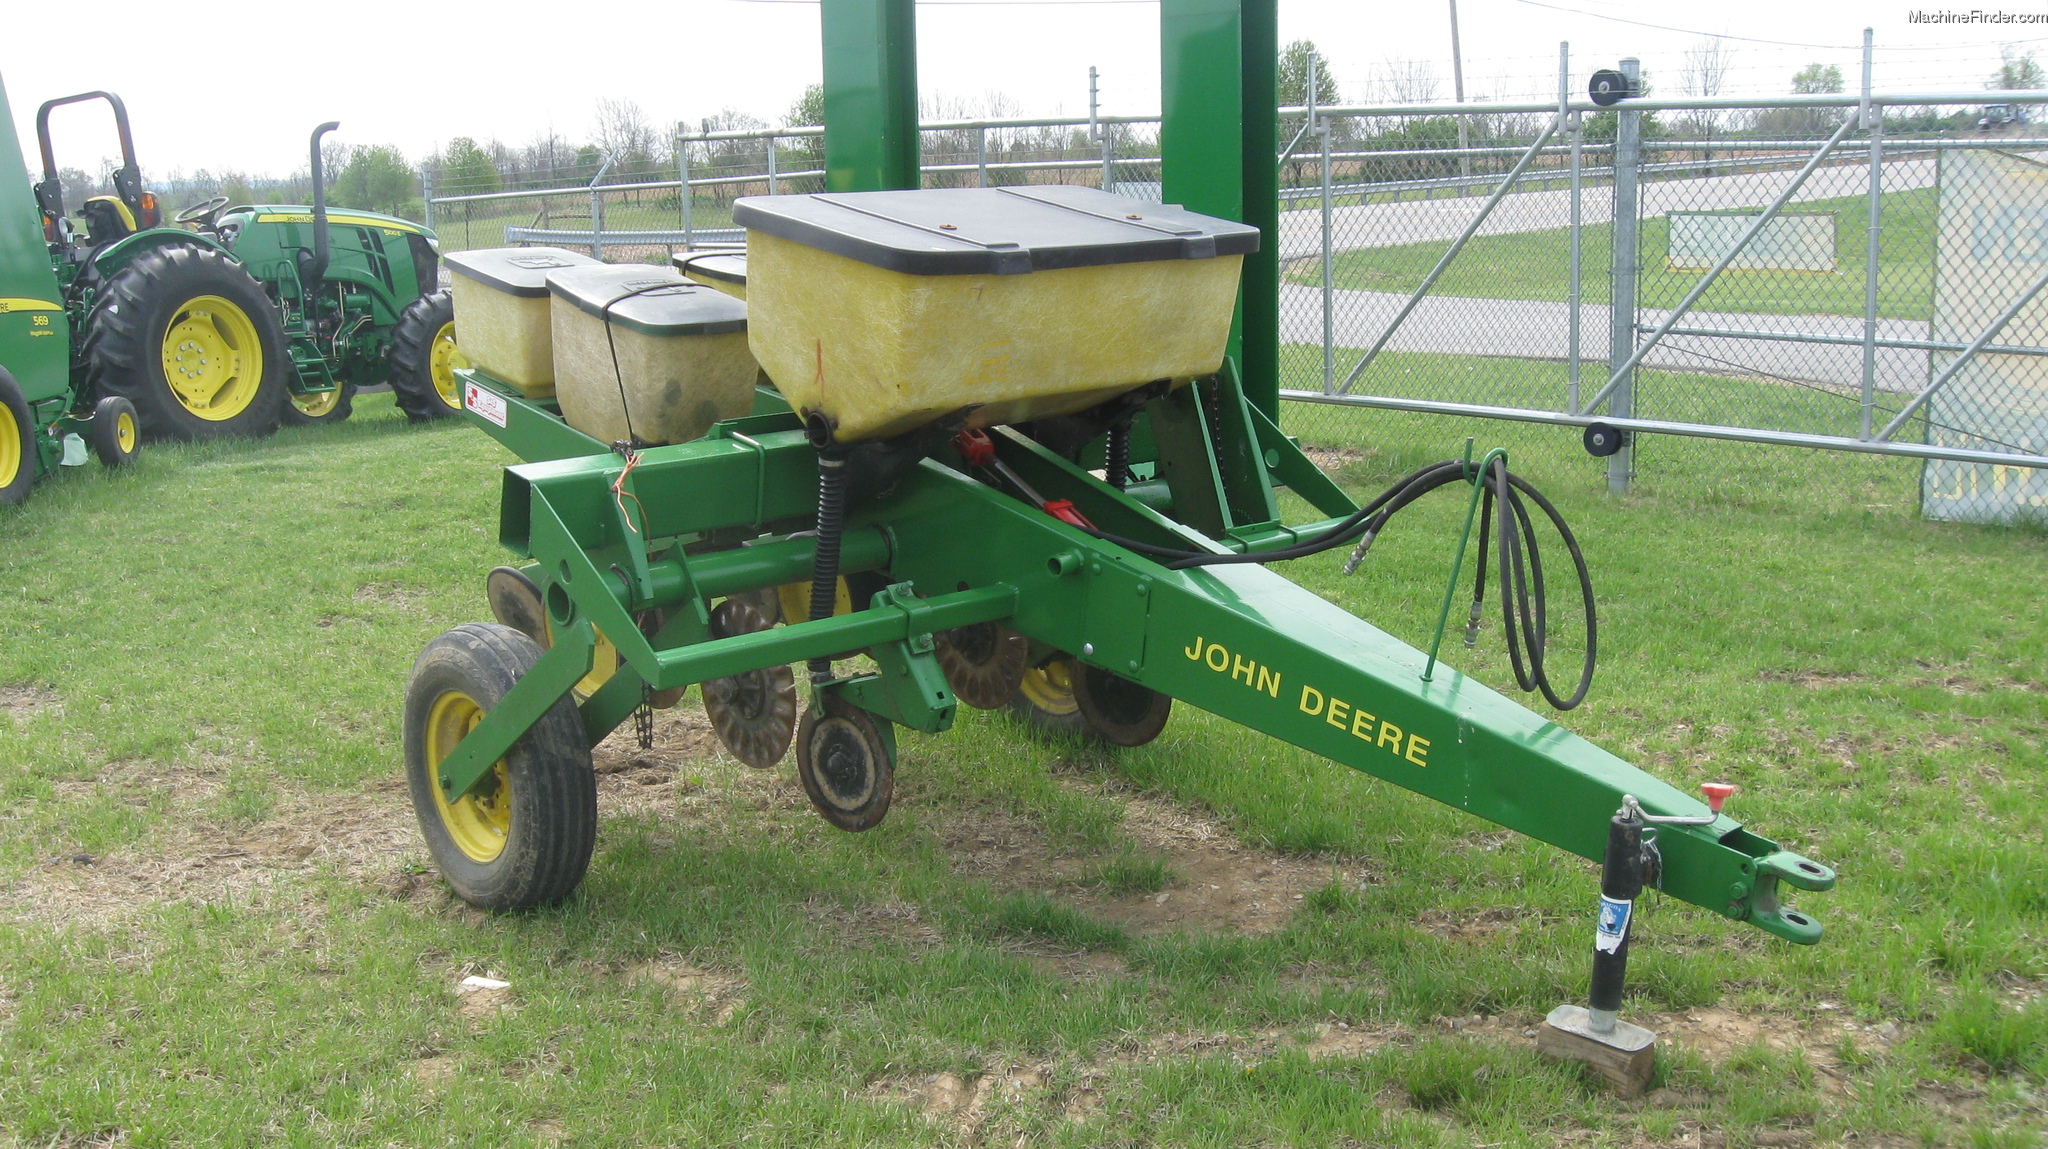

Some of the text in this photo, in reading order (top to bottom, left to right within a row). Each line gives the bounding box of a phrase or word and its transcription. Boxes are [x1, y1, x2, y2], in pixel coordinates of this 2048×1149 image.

[32, 315, 49, 326] 569
[1184, 636, 1431, 768] JOHN DEERE
